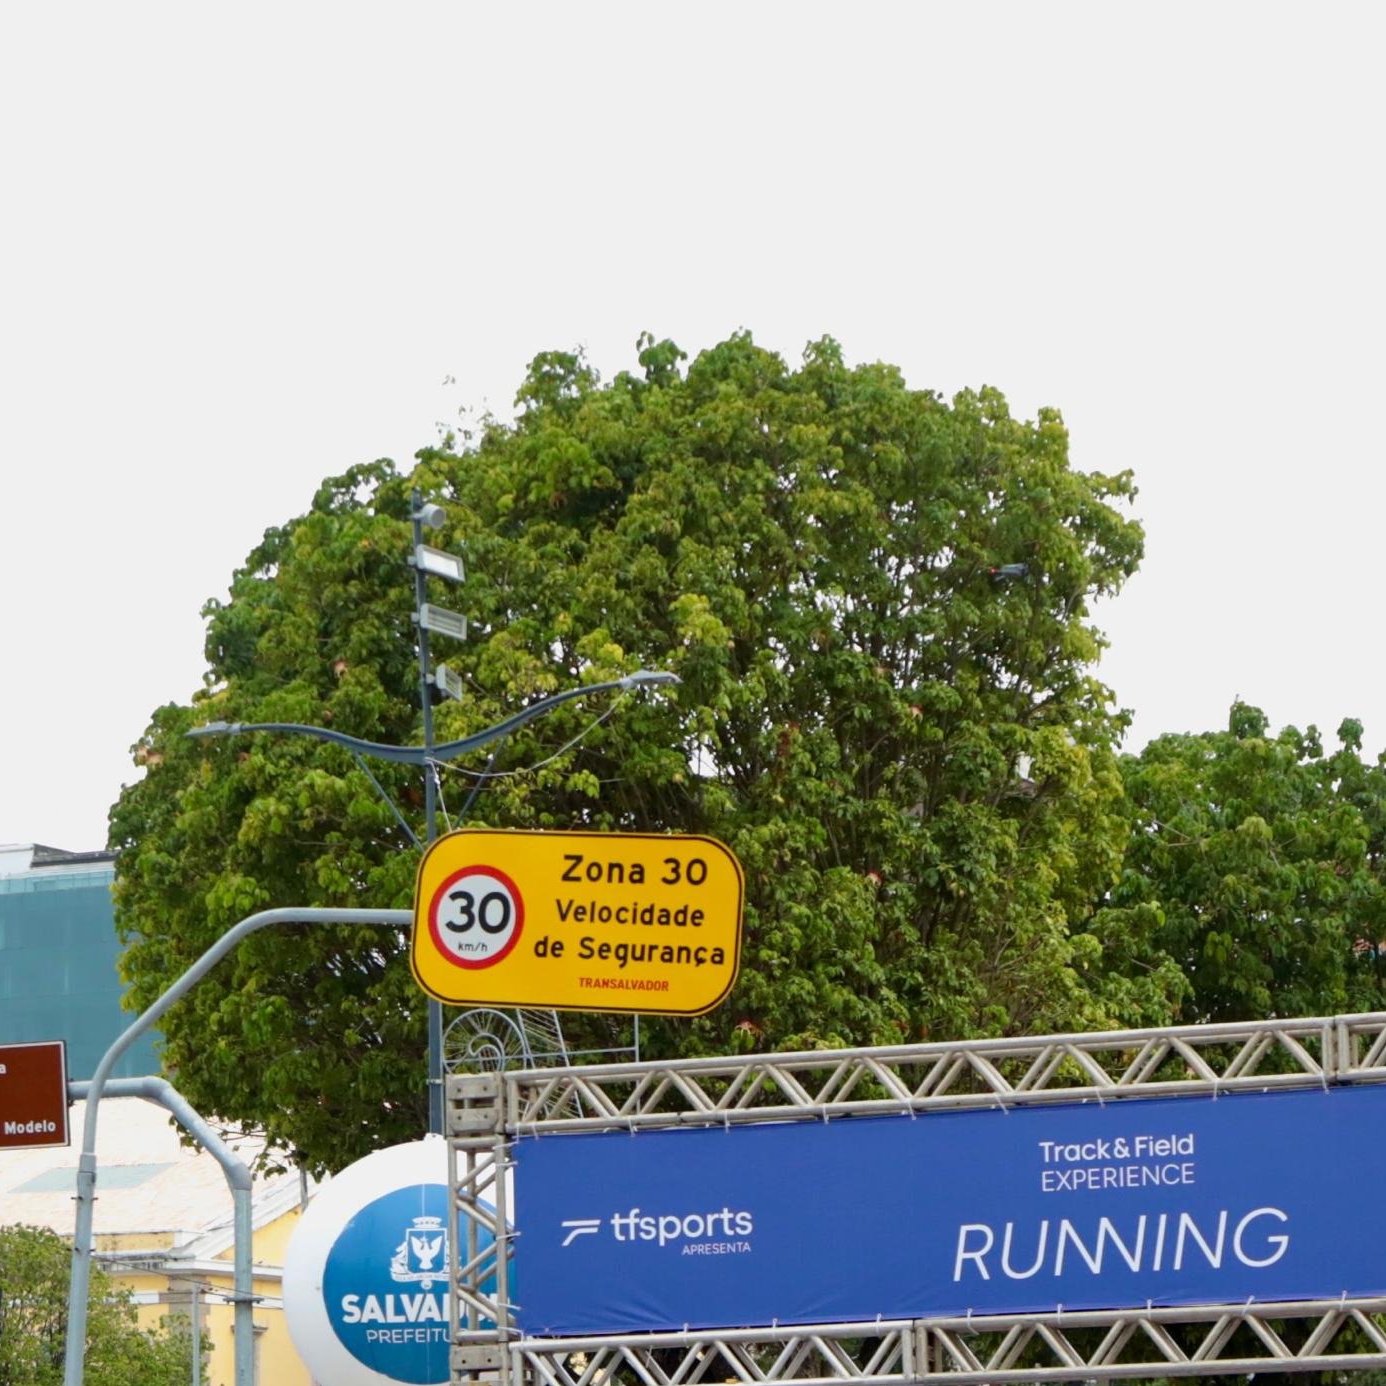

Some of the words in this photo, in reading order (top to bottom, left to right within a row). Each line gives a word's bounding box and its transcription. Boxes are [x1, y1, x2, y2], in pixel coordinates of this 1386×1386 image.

[561, 854, 644, 884] Zona
[662, 857, 708, 886] 30
[445, 890, 510, 934] 30
[556, 899, 705, 927] Velocidade
[458, 941, 488, 953] km/h
[534, 937, 564, 959] de
[579, 937, 725, 968] Segurança
[579, 977, 669, 991] TRANSALVADOR
[5, 1120, 56, 1134] Modelo
[1039, 1139, 1110, 1163] Track
[1135, 1133, 1194, 1157] Field
[1041, 1163, 1195, 1192] EXPERIENCE
[610, 1207, 753, 1246] tfsports
[681, 1242, 751, 1255] APRESENTA
[953, 1207, 1289, 1282] RUNNING
[366, 1328, 466, 1343] PREFEITU
